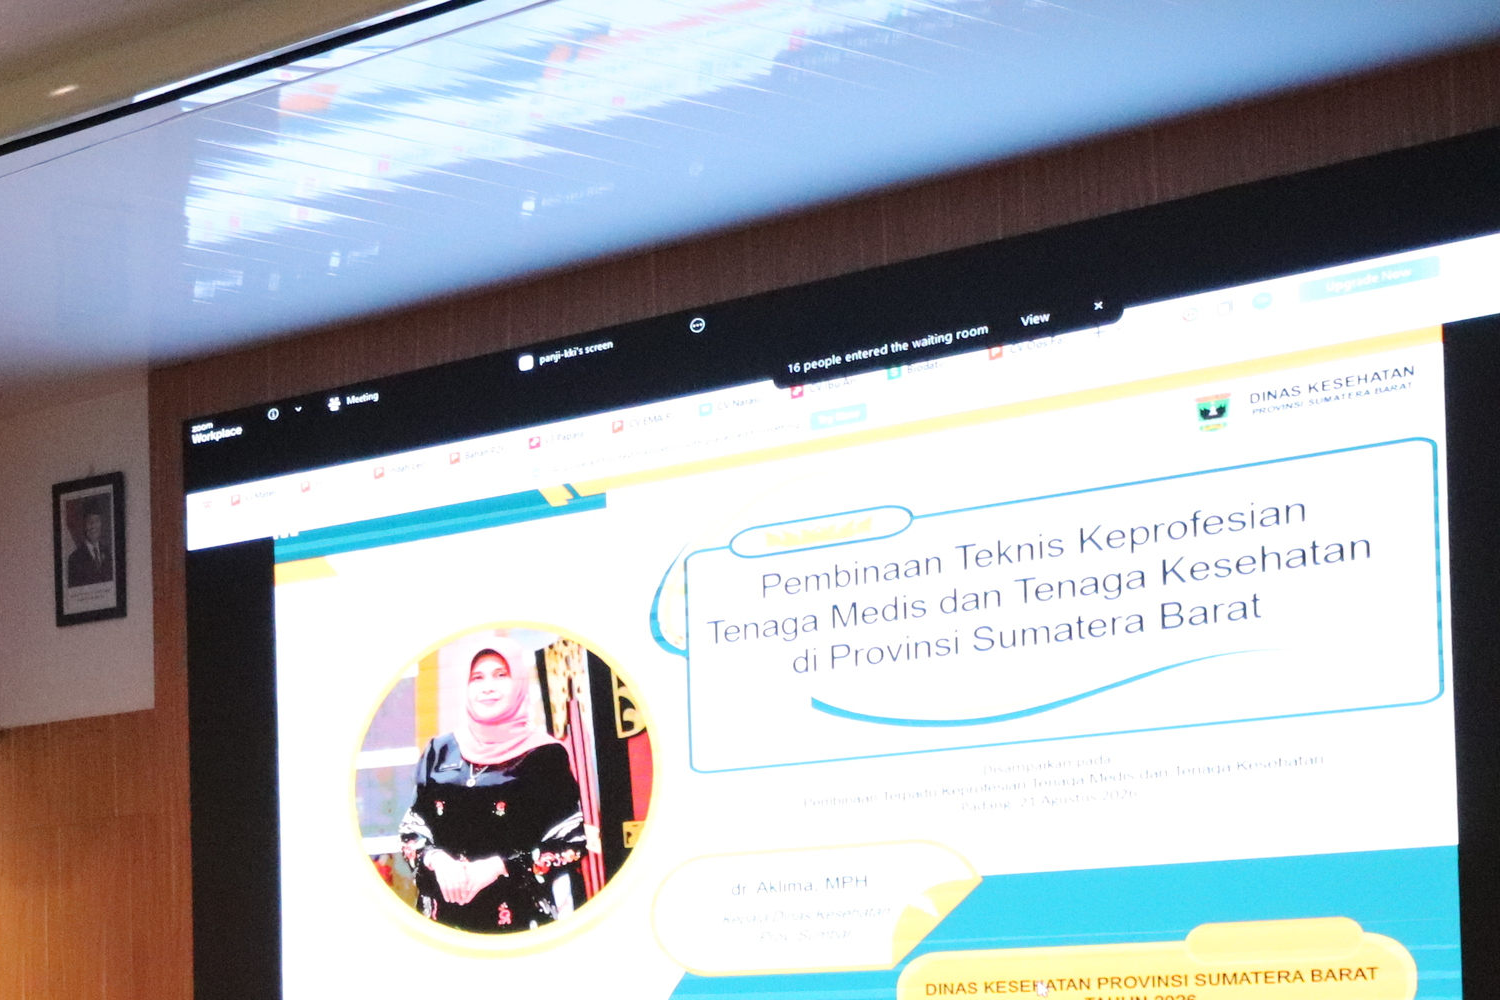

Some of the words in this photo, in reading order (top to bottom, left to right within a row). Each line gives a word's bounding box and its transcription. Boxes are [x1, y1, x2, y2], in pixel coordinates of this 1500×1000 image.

[1325, 273, 1379, 293] Upgrade
[1381, 268, 1412, 282] Now
[585, 341, 614, 354] screen
[787, 363, 801, 374] 16
[803, 354, 842, 373] people
[845, 344, 889, 363] entered
[890, 340, 909, 353] the
[912, 331, 953, 350] waiting
[956, 325, 989, 340] room
[1020, 312, 1050, 327] View
[346, 391, 379, 406] Meeting
[1249, 385, 1302, 405] DINAS
[1308, 364, 1416, 394] KESEHATAN
[1251, 400, 1305, 416] PROVINSI
[1308, 388, 1371, 406] SUMATERA
[1374, 380, 1414, 396] BARAT
[191, 422, 214, 433] zoom
[191, 426, 243, 445] Workplace
[761, 548, 943, 599] Pembinaan
[955, 533, 1065, 571] Teknis
[1079, 499, 1308, 559] Keprofesian
[707, 610, 819, 646] Tenaga
[831, 595, 927, 630] Medis
[939, 585, 1002, 615] dan
[1014, 566, 1147, 604] Tenaga
[1162, 536, 1372, 586] Kesehatan
[792, 647, 818, 675] di
[830, 630, 961, 671] Provinsi
[972, 610, 1145, 654] Sumatera
[1160, 594, 1262, 632] Barat
[1090, 772, 1135, 784] Medis
[1140, 768, 1169, 780] dan
[1236, 754, 1324, 772] Kesehatan
[825, 875, 869, 890] MPH
[925, 981, 978, 996] DINAS
[984, 978, 1091, 994] KESEHATAN
[1097, 974, 1189, 990] PROVINSI
[1195, 970, 1304, 987] SUMATERA
[1311, 966, 1379, 982] BARAT
